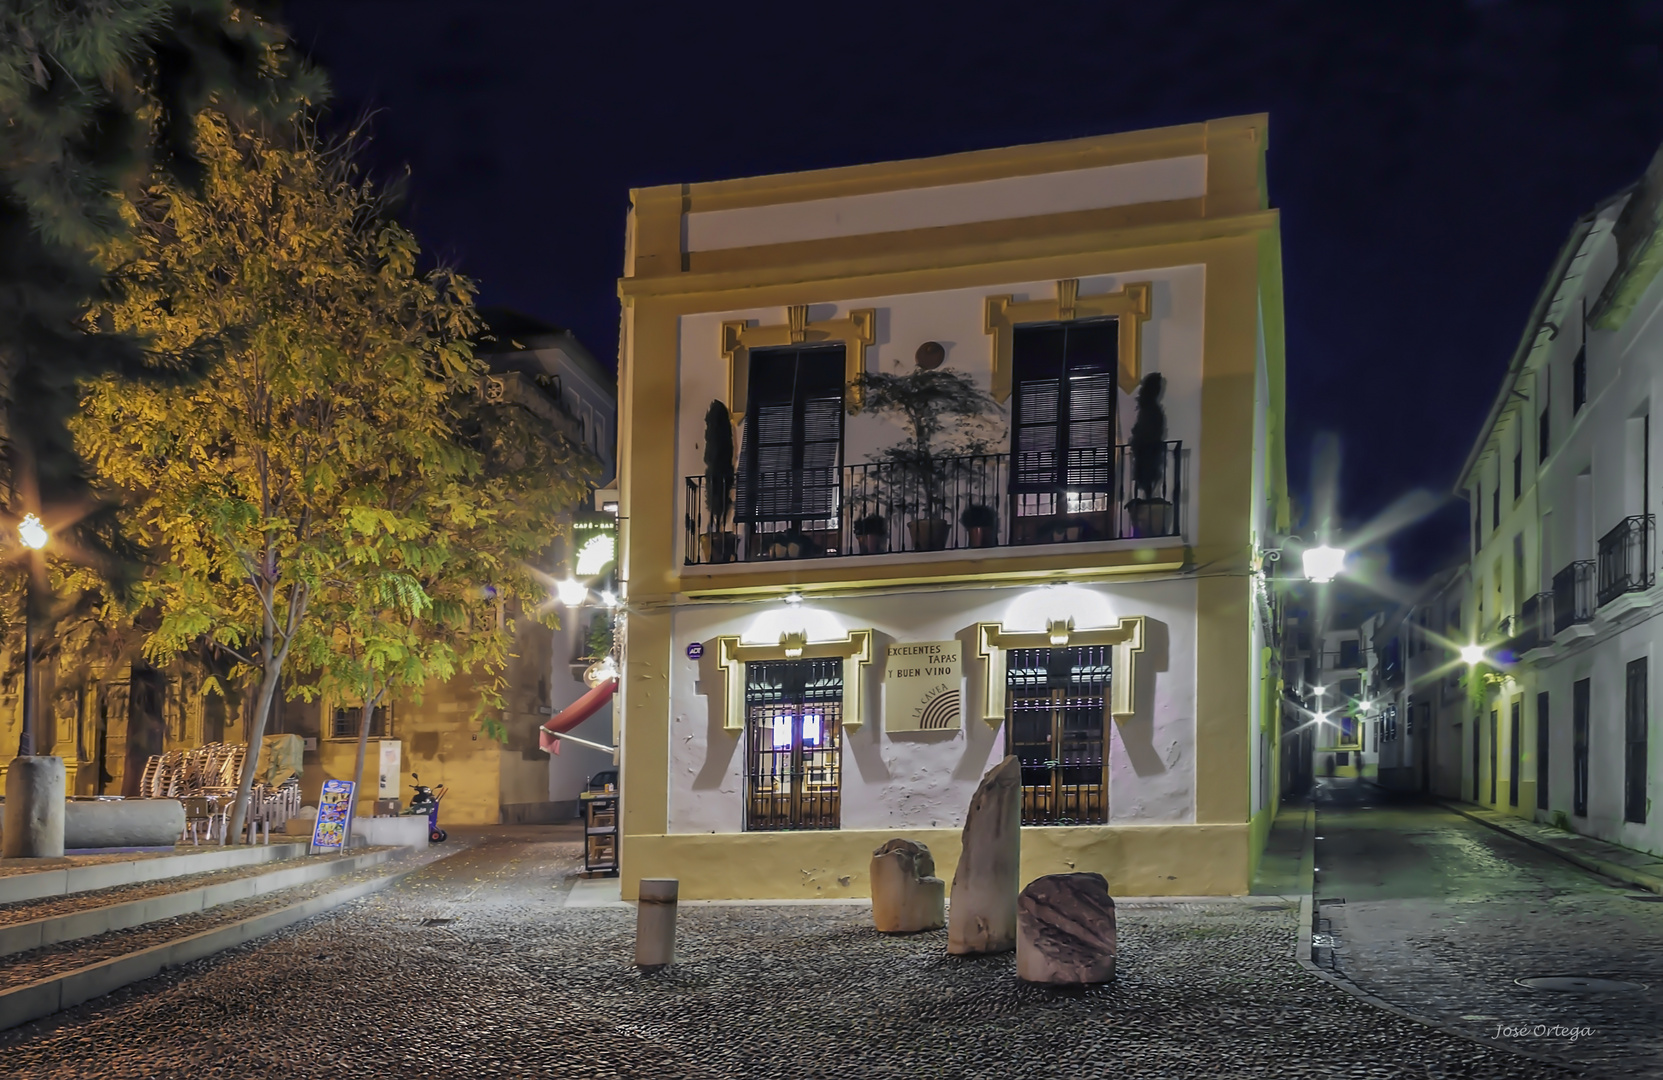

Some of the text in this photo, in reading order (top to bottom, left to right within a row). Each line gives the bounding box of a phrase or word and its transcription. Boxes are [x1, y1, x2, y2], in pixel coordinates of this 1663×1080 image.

[887, 645, 941, 656] EXCELENTES
[929, 654, 957, 664] TAPAS
[888, 667, 951, 678] Y BUEN VINO
[912, 683, 949, 718] LA CAVEA
